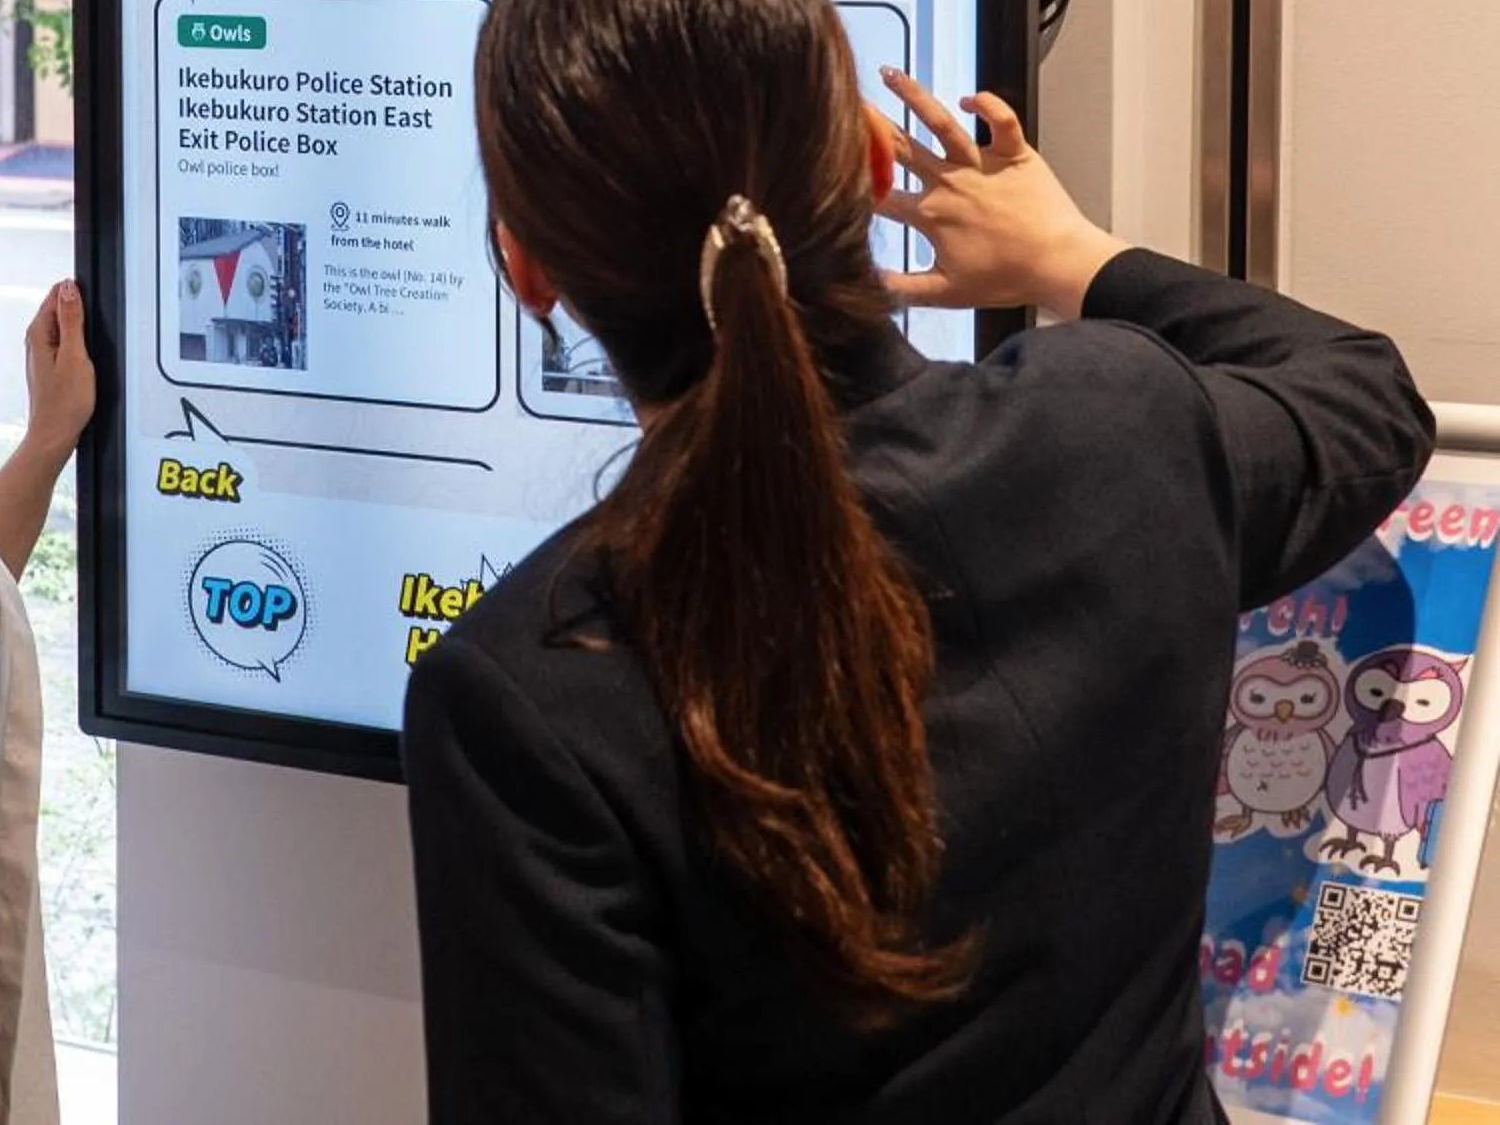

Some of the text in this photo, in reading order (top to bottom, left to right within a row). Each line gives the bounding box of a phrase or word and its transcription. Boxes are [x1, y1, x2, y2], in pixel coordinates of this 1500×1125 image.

[209, 23, 251, 43] Owls
[179, 67, 453, 99] Ikebukuro Police Station
[179, 98, 432, 129] Ikebukuro Station East
[179, 129, 339, 156] Exit Police Box
[178, 159, 280, 178] Owl police box!
[356, 210, 451, 228] 11 minutes walk
[331, 235, 415, 251] from the hotel
[324, 264, 347, 277] This
[349, 265, 357, 277] is
[360, 266, 379, 279] the
[380, 268, 401, 280] owl
[323, 281, 341, 294] the
[373, 284, 397, 297] Tree
[400, 285, 449, 301] Creation
[157, 457, 243, 502] Back
[201, 576, 296, 631] TOP
